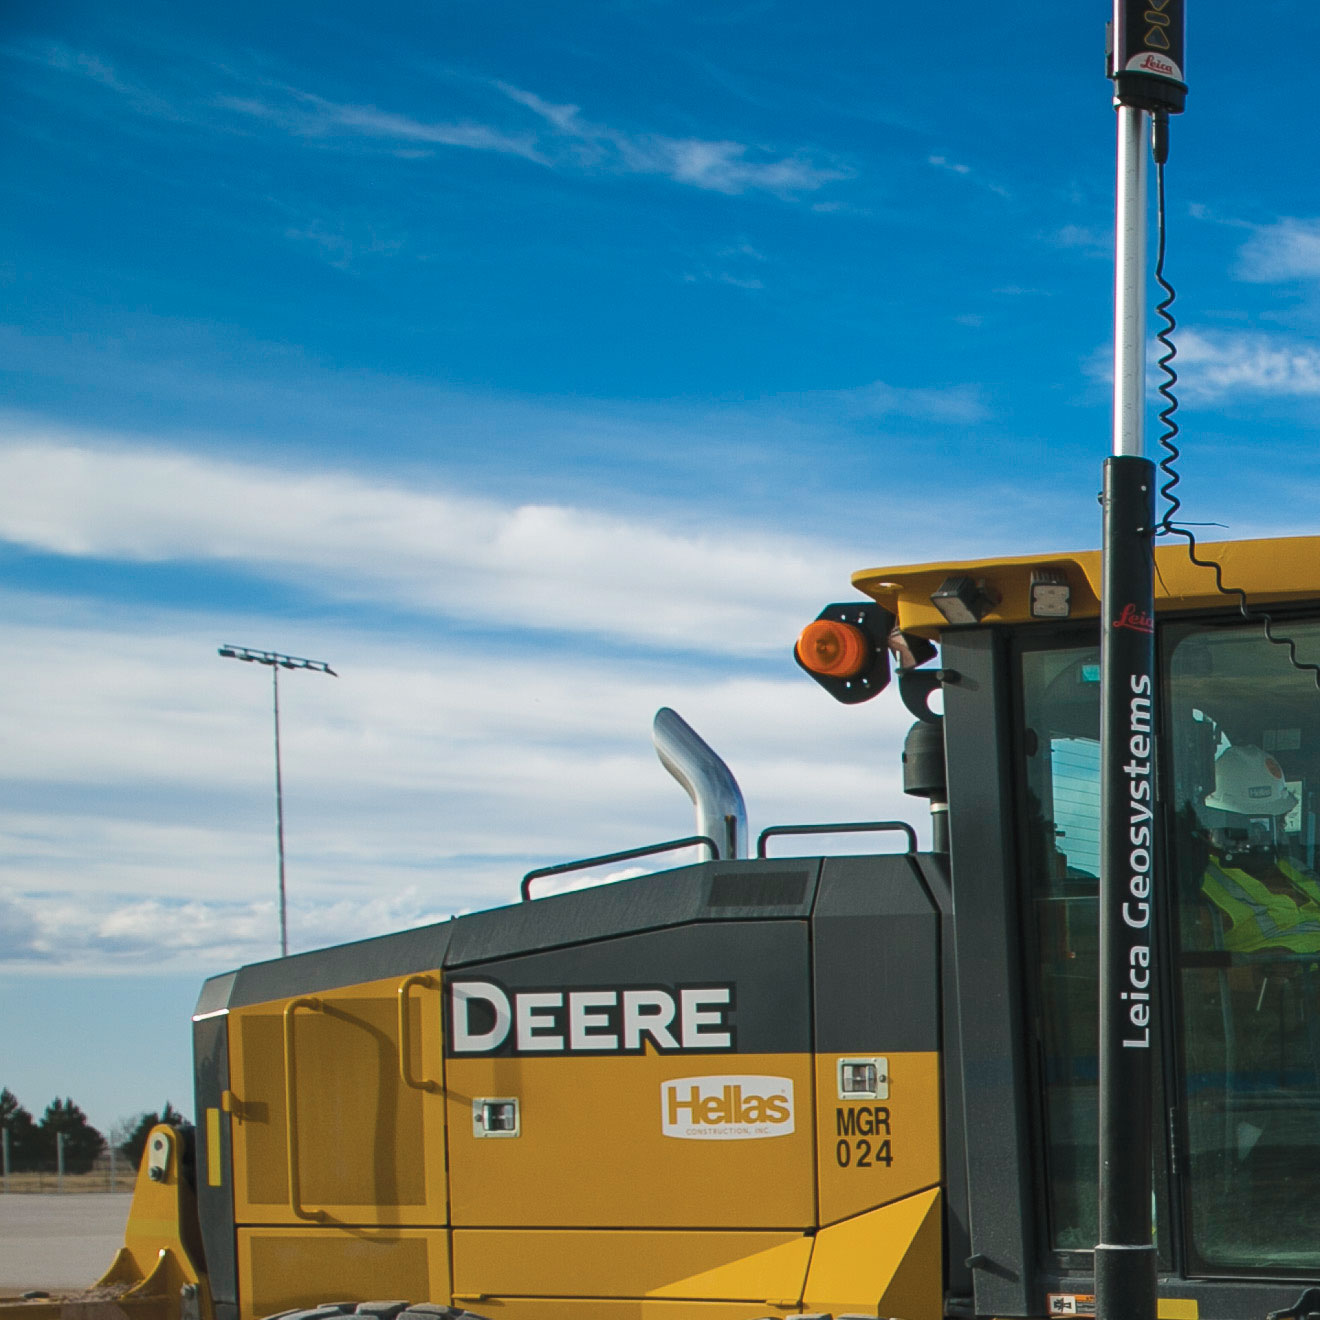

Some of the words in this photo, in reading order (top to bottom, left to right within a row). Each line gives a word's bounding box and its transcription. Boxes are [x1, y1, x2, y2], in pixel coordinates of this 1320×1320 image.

[1140, 54, 1173, 75] Leica
[1122, 674, 1153, 929] Geosystems
[450, 980, 733, 1053] DEERE
[1121, 945, 1150, 1048] Leica
[667, 1085, 791, 1126] Hellas
[836, 1106, 891, 1137] MGR
[836, 1138, 893, 1168] 024
